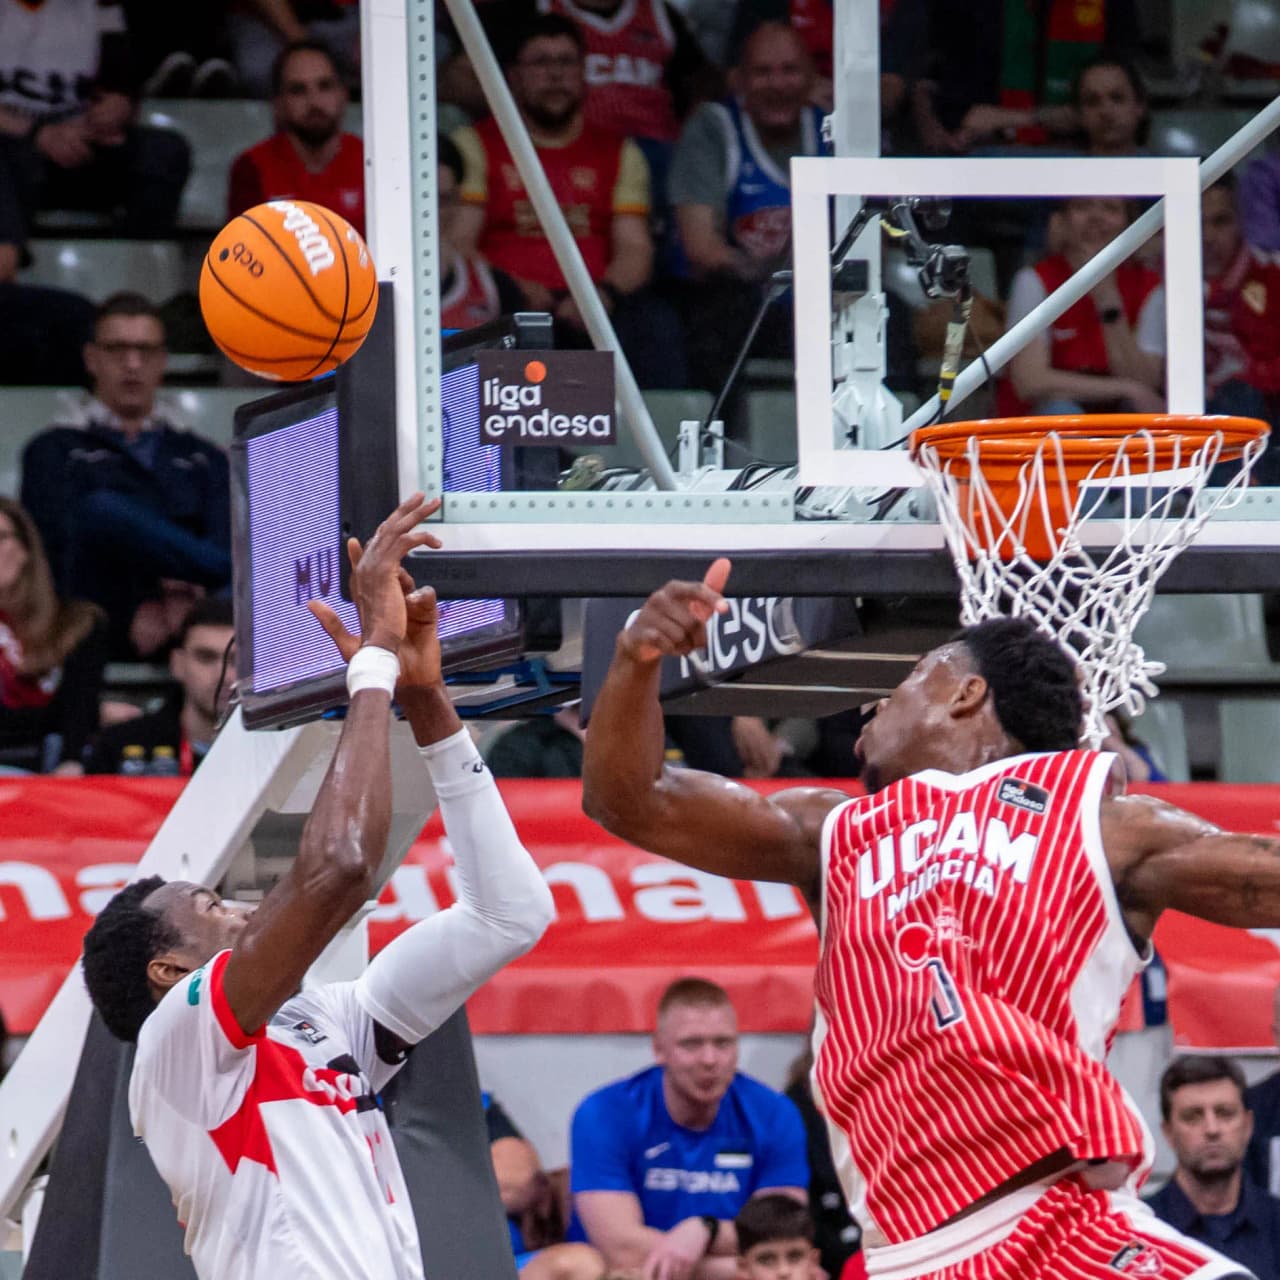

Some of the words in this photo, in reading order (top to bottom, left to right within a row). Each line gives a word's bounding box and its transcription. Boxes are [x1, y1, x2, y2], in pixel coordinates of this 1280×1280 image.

[483, 379, 542, 411] liga
[484, 411, 612, 440] endesa
[858, 809, 1040, 901] UCAM
[887, 857, 997, 923] MURCIA
